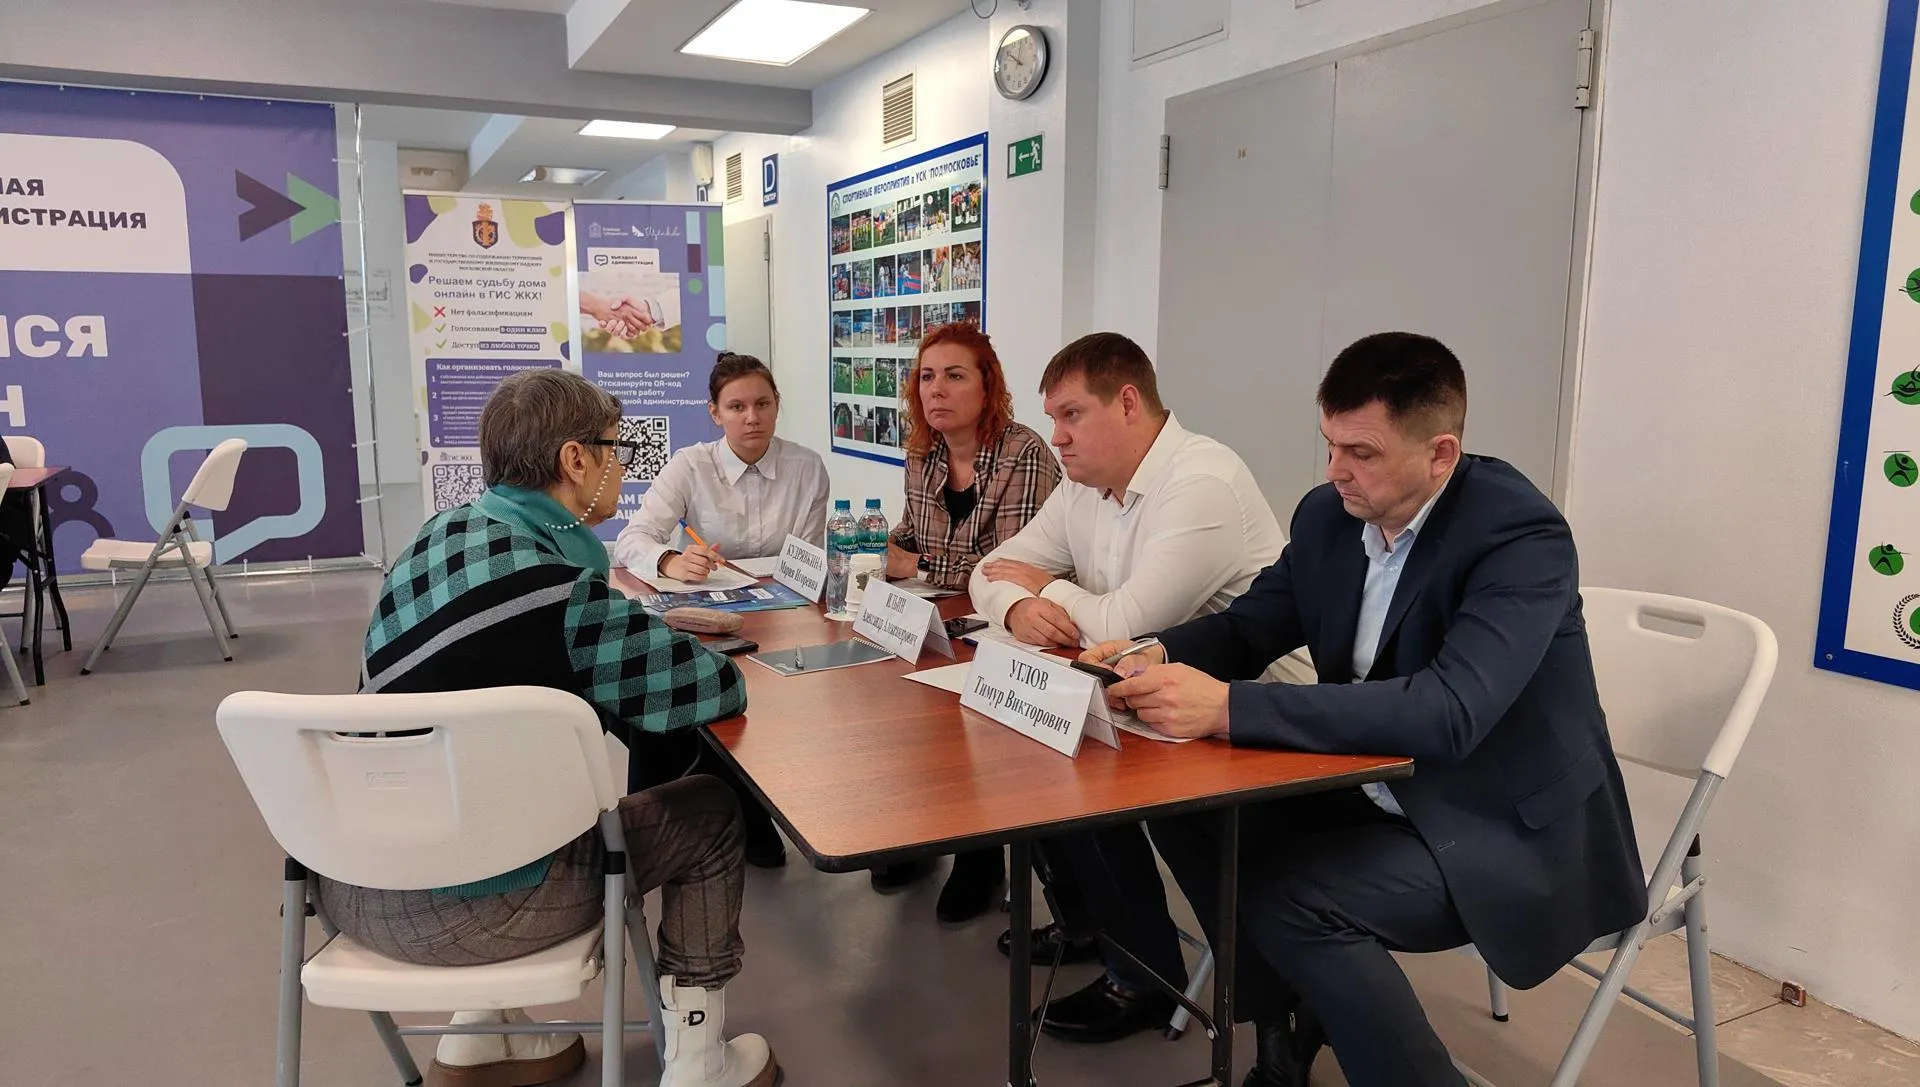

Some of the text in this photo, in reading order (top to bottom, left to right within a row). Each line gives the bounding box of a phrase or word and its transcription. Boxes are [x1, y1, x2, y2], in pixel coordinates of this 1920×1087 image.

[764, 159, 776, 193] D
[0, 177, 45, 197] АЯ
[873, 175, 910, 196] МЕРОПРИЯТИЯ
[915, 169, 928, 182] УСК
[428, 276, 547, 288] Решаем судьбу дома
[434, 290, 476, 299] онлайн
[489, 291, 512, 300] ГИС
[515, 291, 542, 301] ЖКХ!
[466, 309, 533, 317] фальсификациям
[0, 314, 109, 358] СЯ
[451, 341, 480, 349] Доступ
[452, 364, 502, 372] организовать
[661, 371, 690, 379] решен?
[598, 380, 653, 388] Отсканируйте
[617, 494, 636, 505] АМ
[780, 559, 796, 579] Мария
[1009, 658, 1049, 691] УГЛОВ
[973, 675, 1072, 735] Тимур Викторович
